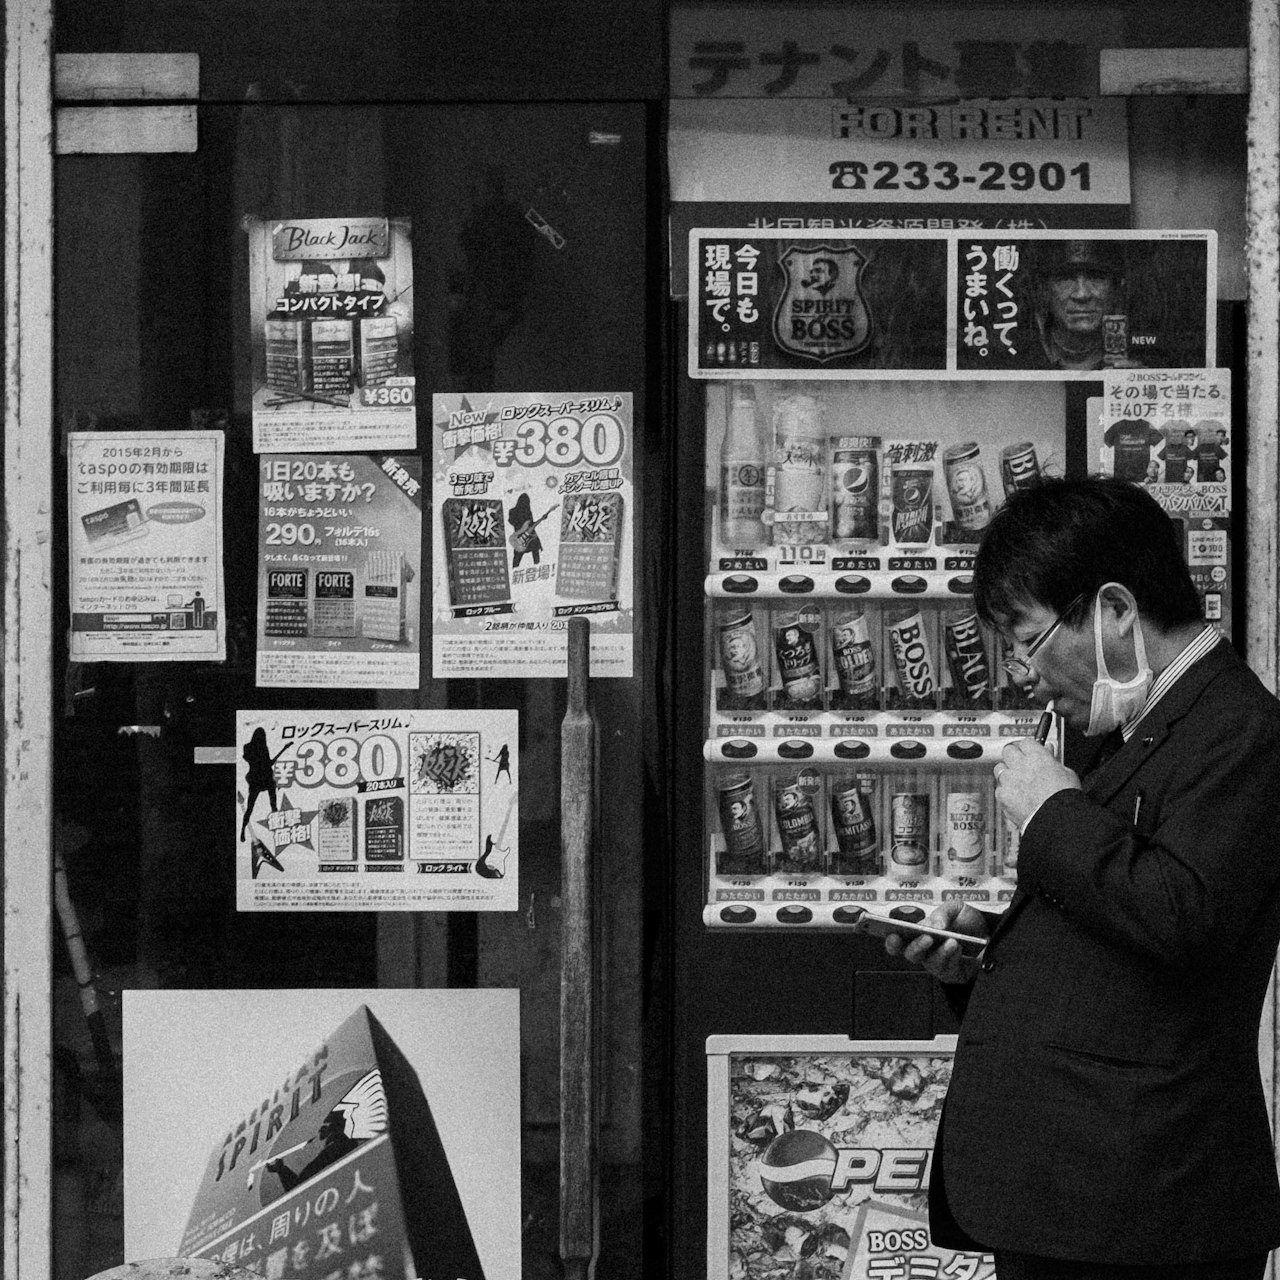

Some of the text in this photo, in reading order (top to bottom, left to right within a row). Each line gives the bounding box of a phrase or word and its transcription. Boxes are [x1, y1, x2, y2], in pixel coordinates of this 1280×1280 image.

[830, 105, 1094, 141] FOR RENT
[282, 225, 380, 252] Black Jack
[704, 244, 732, 333] 現場で。
[734, 243, 761, 324] 今日も
[276, 294, 386, 313] コンパクトタイプ
[963, 244, 990, 357] うまいね。
[992, 244, 1020, 356] 働くって、
[790, 317, 856, 341] BOSS
[1131, 335, 1157, 345] NEW
[364, 387, 413, 405] ¥360
[1110, 384, 1226, 400] その場で当たる。
[448, 410, 488, 429] New
[493, 413, 625, 468] ¥380
[102, 447, 183, 458] 2015年2月から
[887, 441, 939, 464] 強刺激
[77, 461, 209, 477] taspoの有効期限は
[262, 460, 356, 482] 1日20本も
[380, 457, 422, 498] 新発売
[76, 480, 210, 494] ご利用毎に3年間延長
[262, 482, 377, 503] 吸いますか?
[1200, 485, 1228, 494] BOSS
[263, 507, 353, 518] 16本がちょうどいい
[265, 523, 322, 546] 290円
[779, 546, 827, 561] 110円
[722, 560, 765, 570] つめたい
[835, 560, 878, 570] つめたい
[891, 560, 934, 570] つめたい
[270, 572, 304, 588] FORTE
[318, 573, 351, 589] FORTE
[896, 621, 934, 700] BOSS
[953, 618, 990, 700] BLACK
[281, 717, 403, 740] ロックスーパースリム
[779, 725, 819, 736] あたたかい
[835, 725, 875, 736] あたたかい
[891, 725, 931, 736] あたたかい
[948, 725, 988, 736] あたたかい
[273, 733, 402, 790] ¥380
[273, 823, 312, 847] 価格!
[868, 1229, 928, 1252] BOSS
